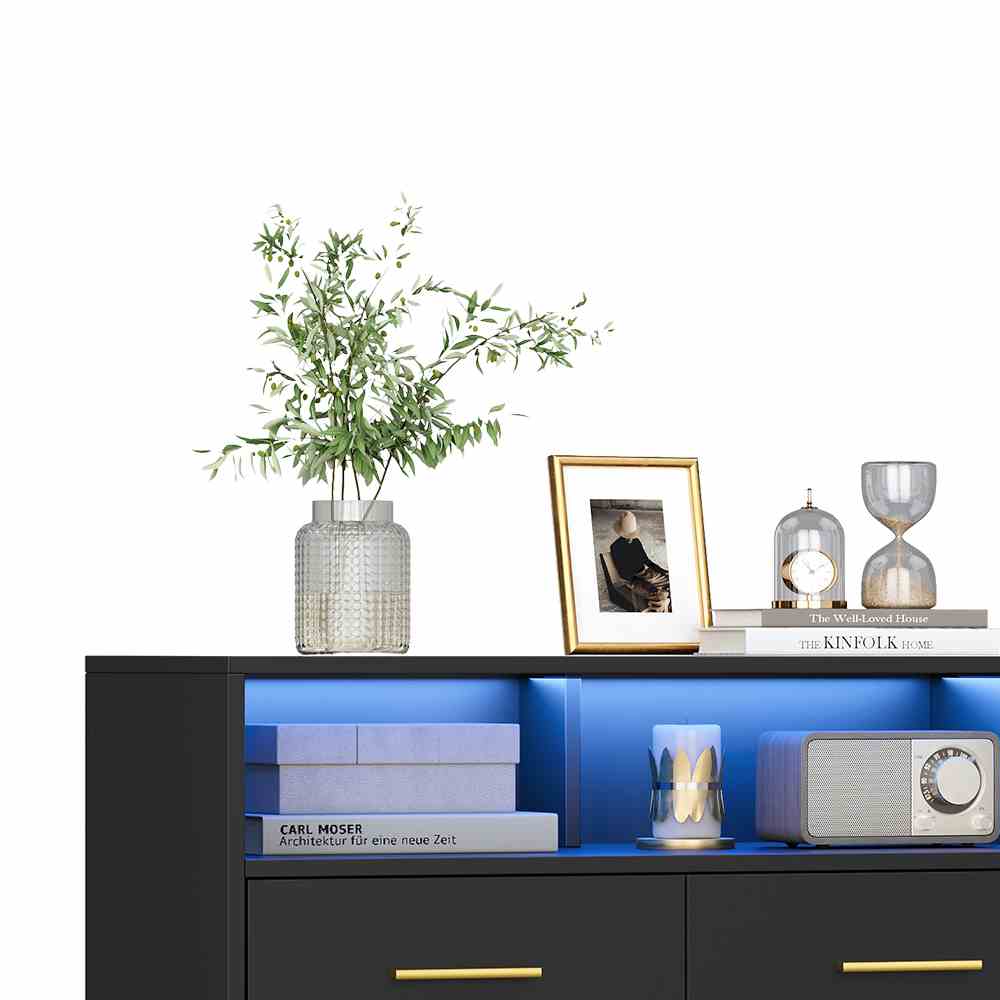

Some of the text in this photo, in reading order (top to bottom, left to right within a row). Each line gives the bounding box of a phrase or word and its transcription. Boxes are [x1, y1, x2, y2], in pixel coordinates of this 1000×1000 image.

[809, 613, 929, 624] The Well-Loved House
[800, 635, 934, 650] THE KINFOLK HOME
[280, 823, 363, 835] CARL MOSER
[279, 834, 457, 847] Architektur für eine neue Zeit
